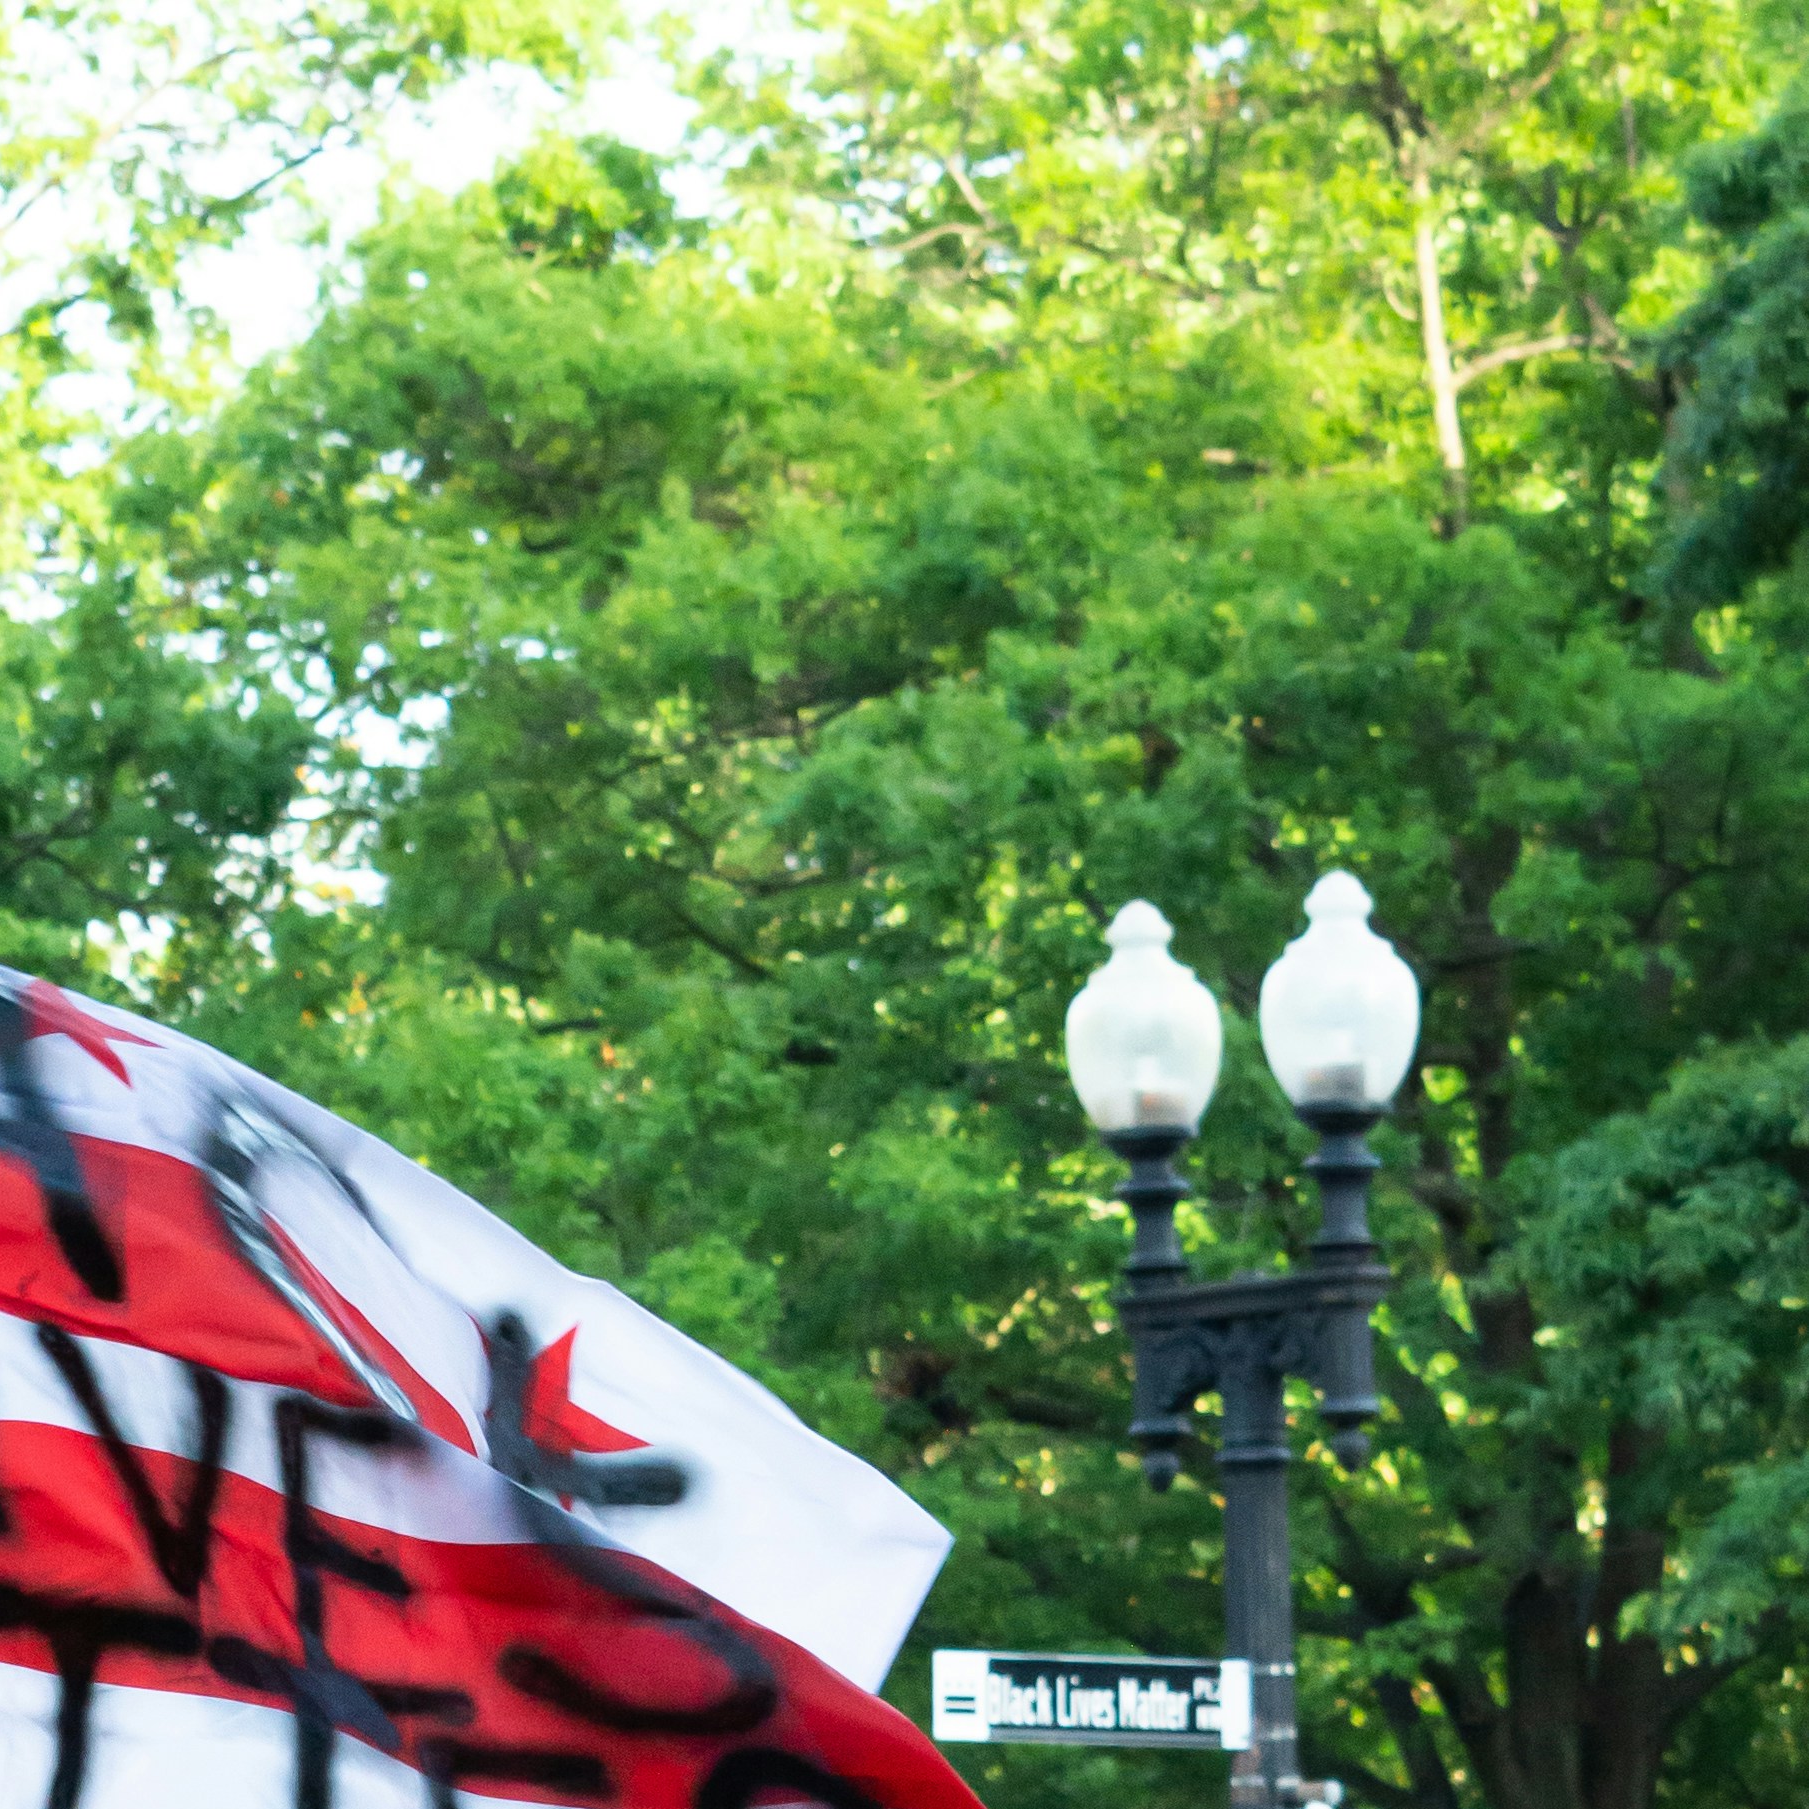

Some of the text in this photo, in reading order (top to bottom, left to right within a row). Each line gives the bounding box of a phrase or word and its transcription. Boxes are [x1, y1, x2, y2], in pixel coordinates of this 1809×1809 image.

[988, 1672, 1190, 1731] Black Lives Matter
